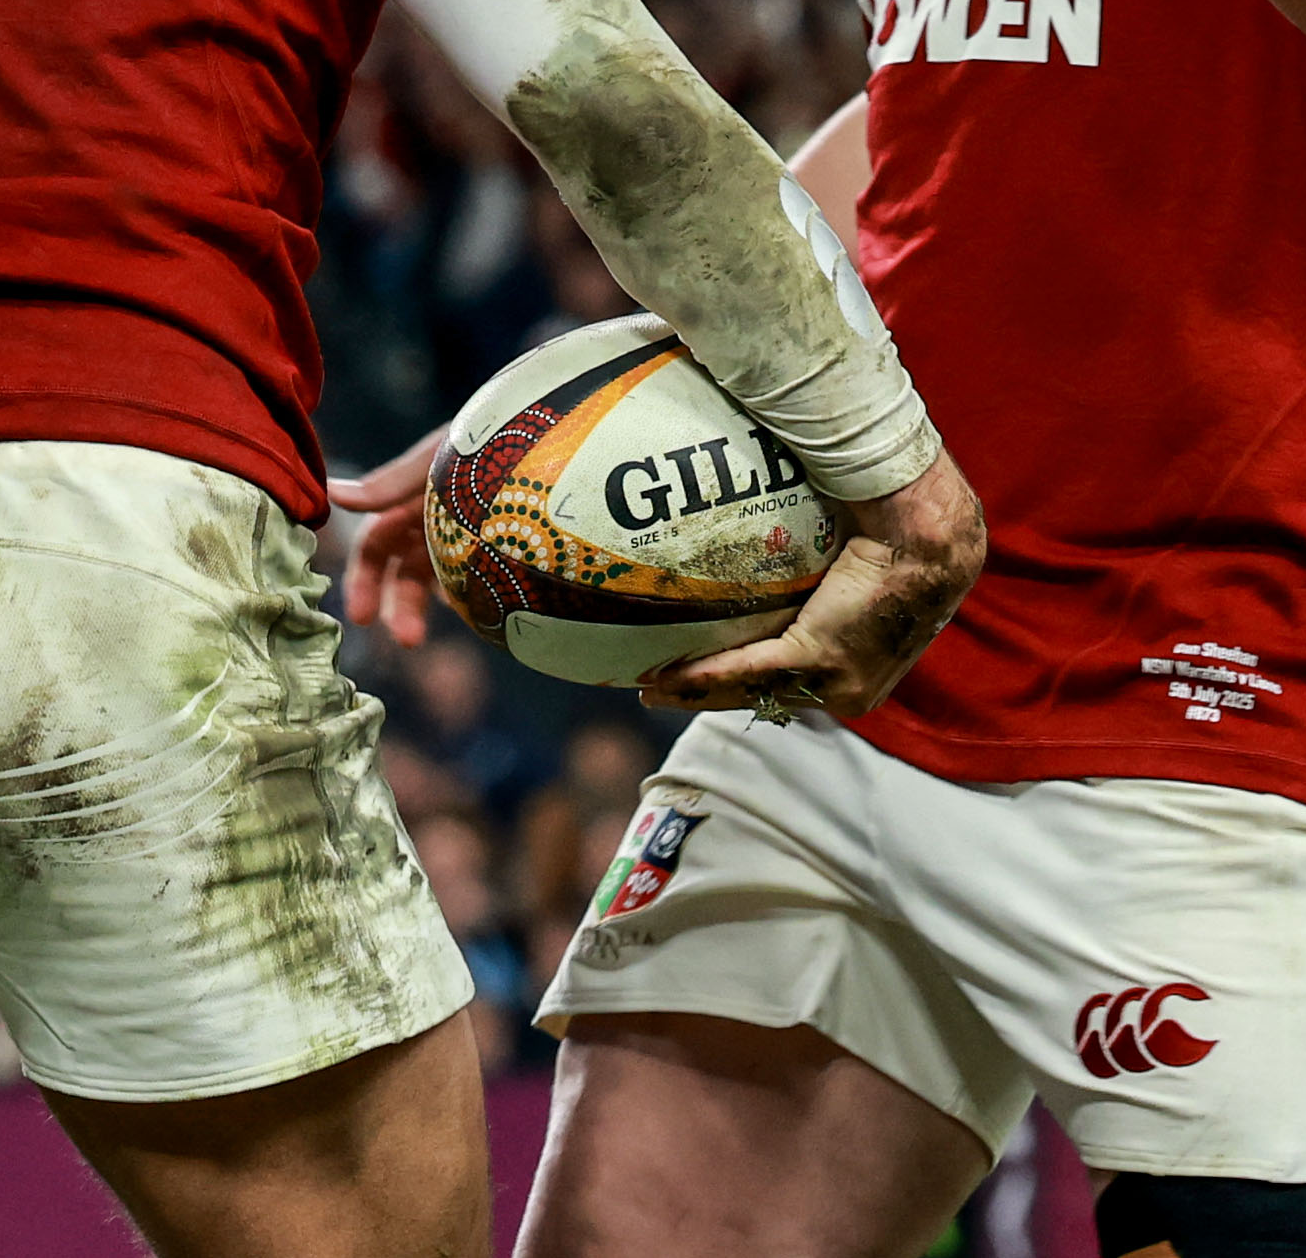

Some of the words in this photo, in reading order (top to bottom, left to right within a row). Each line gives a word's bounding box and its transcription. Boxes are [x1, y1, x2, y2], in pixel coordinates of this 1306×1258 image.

[630, 530, 661, 549] SIZE
[671, 526, 679, 538] 5
[1168, 682, 1192, 699] 5th
[1191, 685, 1222, 707] July
[1220, 690, 1256, 710] 2025
